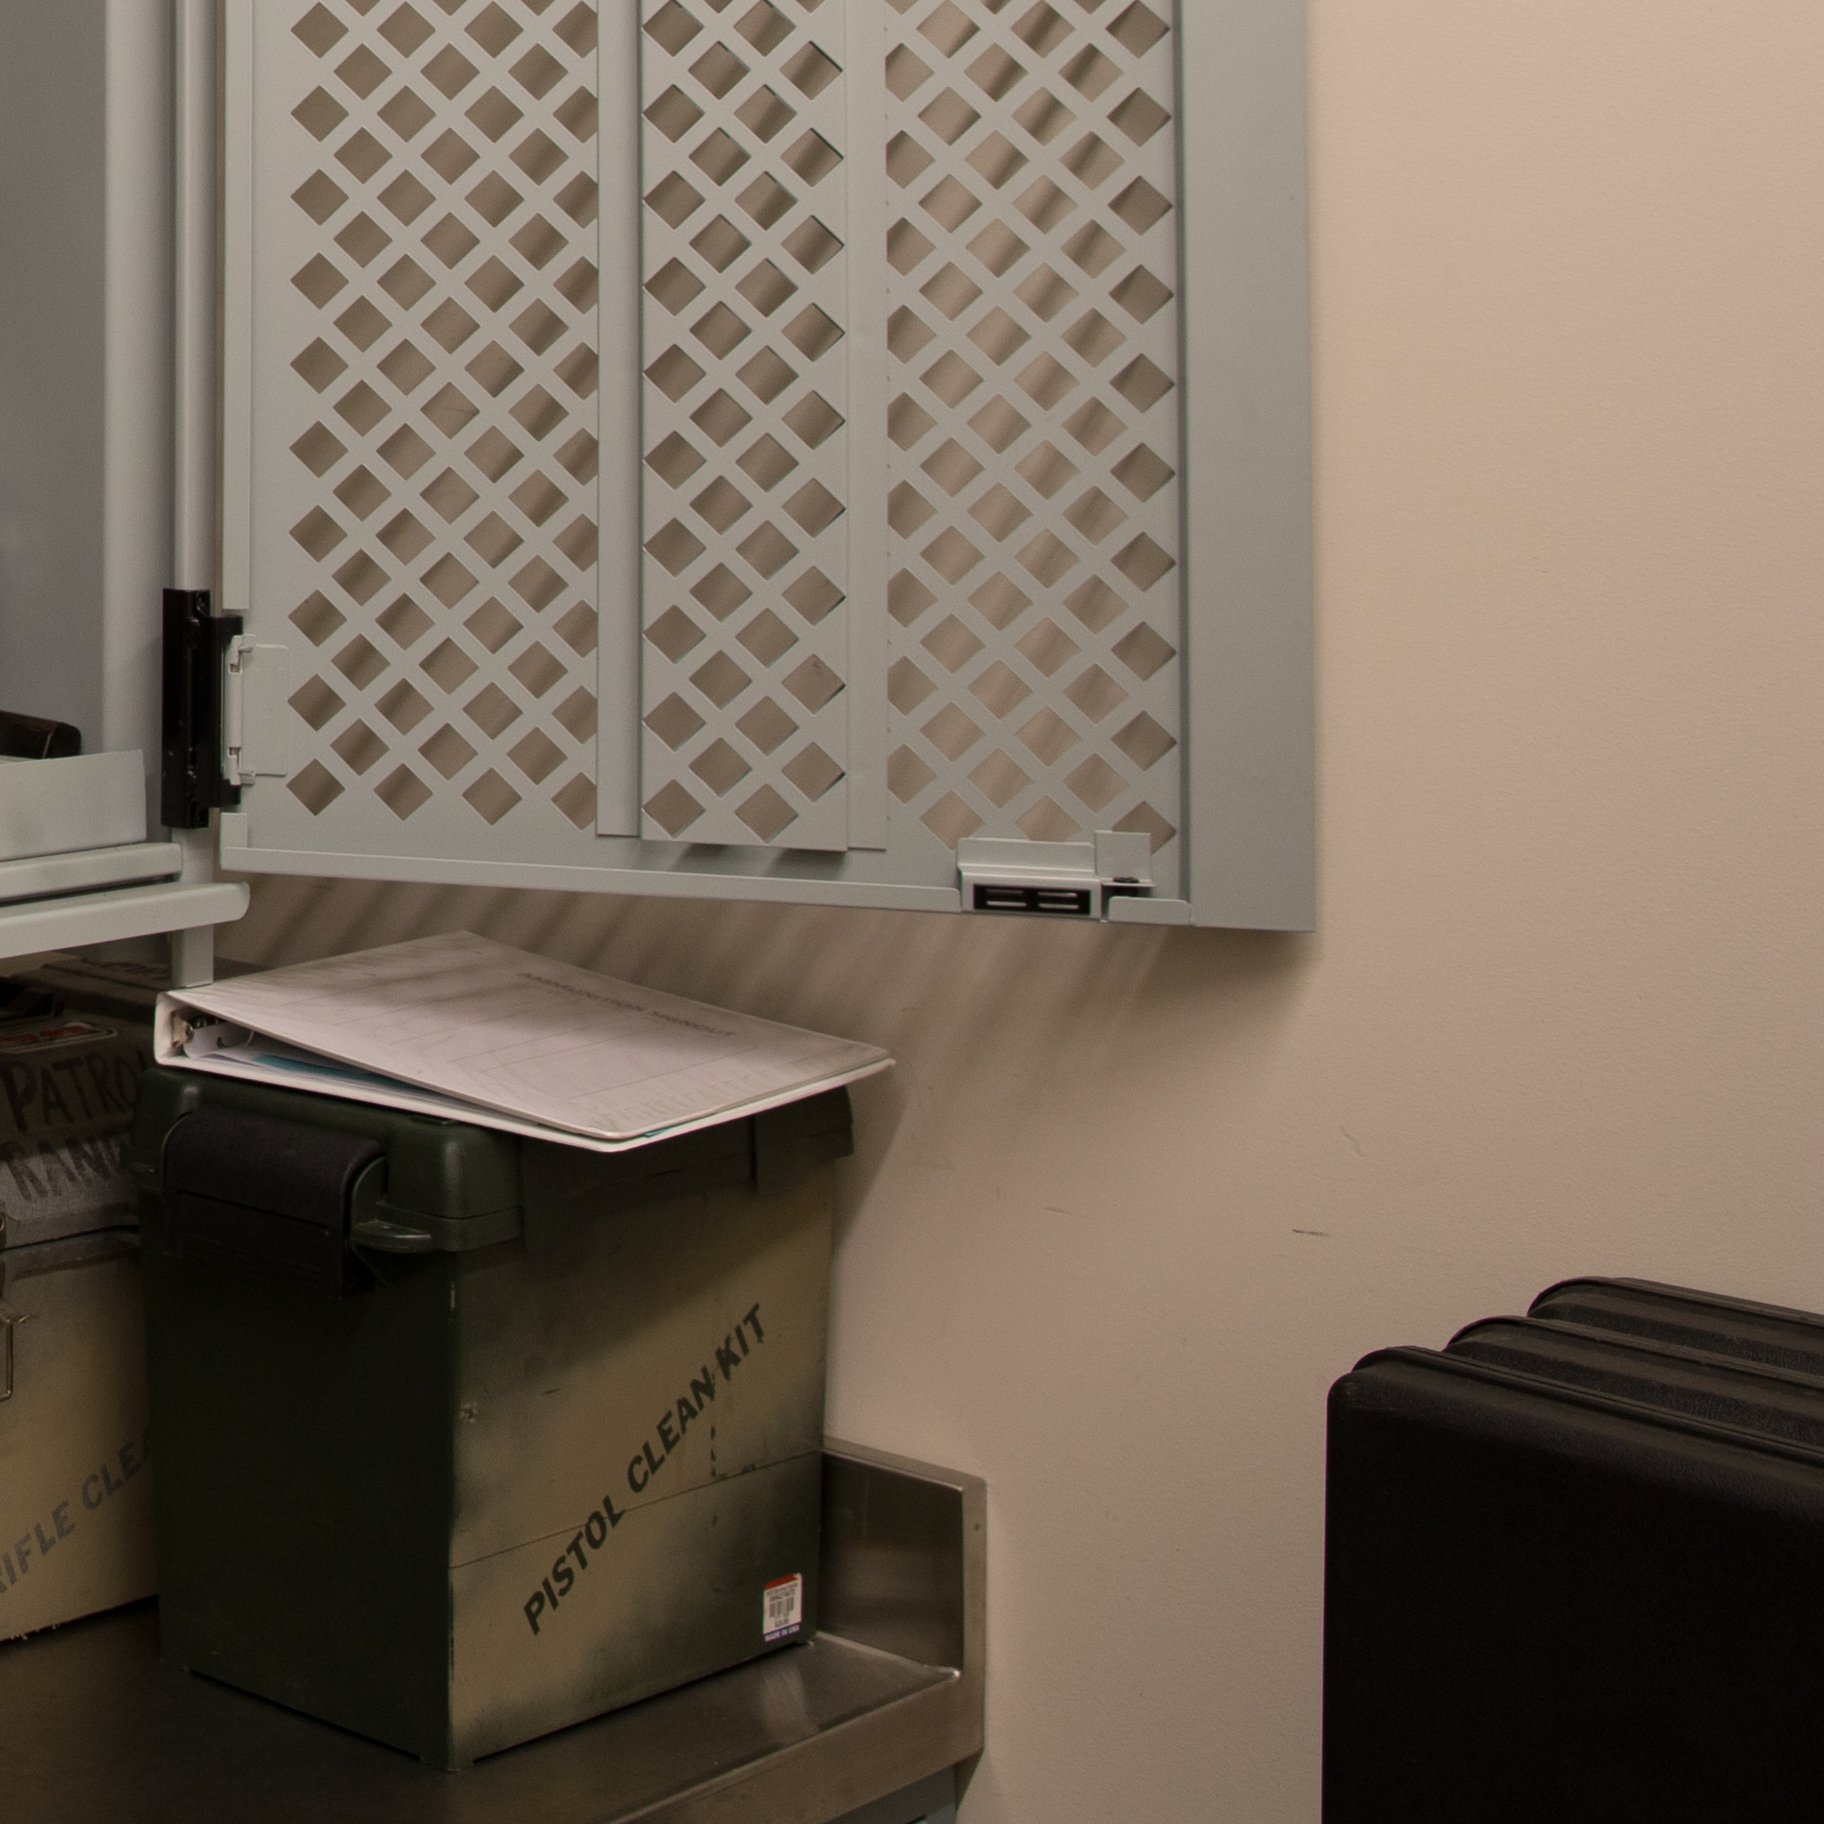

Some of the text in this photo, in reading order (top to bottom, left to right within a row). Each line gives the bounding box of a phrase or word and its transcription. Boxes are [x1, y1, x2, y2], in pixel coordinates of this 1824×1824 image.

[523, 1303, 765, 1636] PISTOL CLEAN KIT
